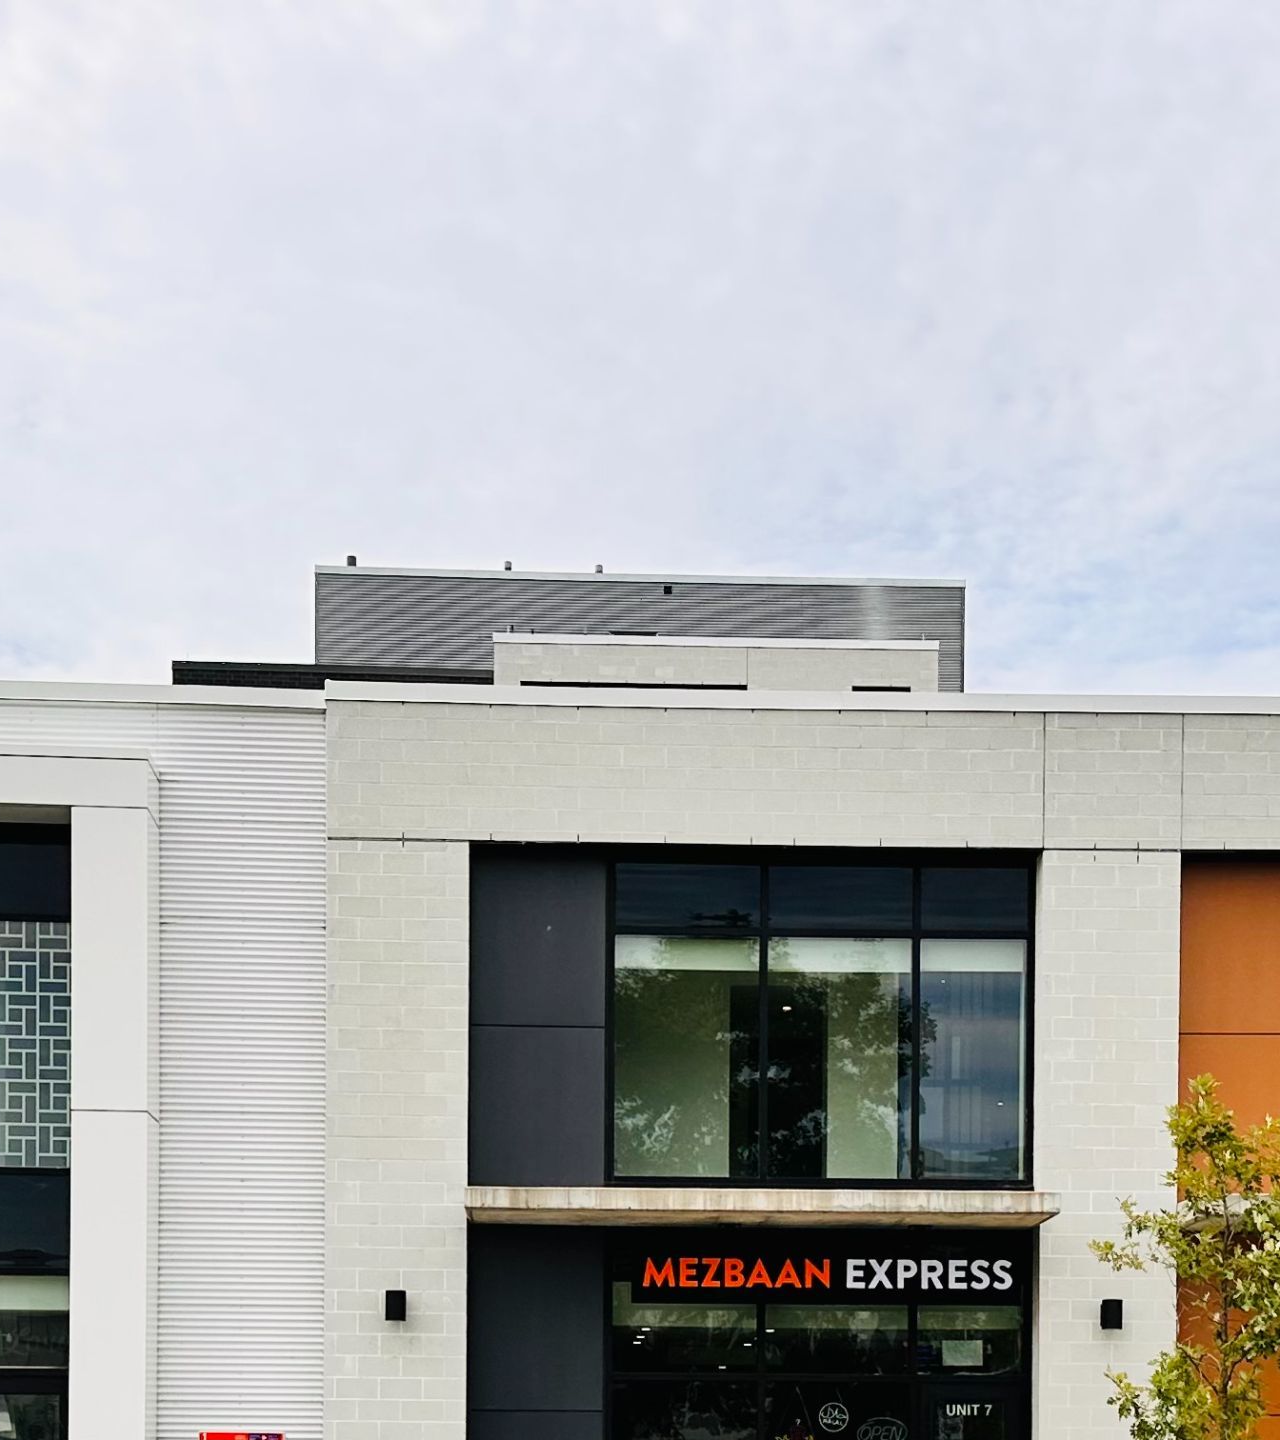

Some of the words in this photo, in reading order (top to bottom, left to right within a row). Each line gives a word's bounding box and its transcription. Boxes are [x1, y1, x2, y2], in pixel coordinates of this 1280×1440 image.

[642, 1257, 831, 1289] MEZBAAN
[846, 1259, 1014, 1290] EXPRESS
[946, 1404, 981, 1416] UNIT
[984, 1404, 993, 1416] 7
